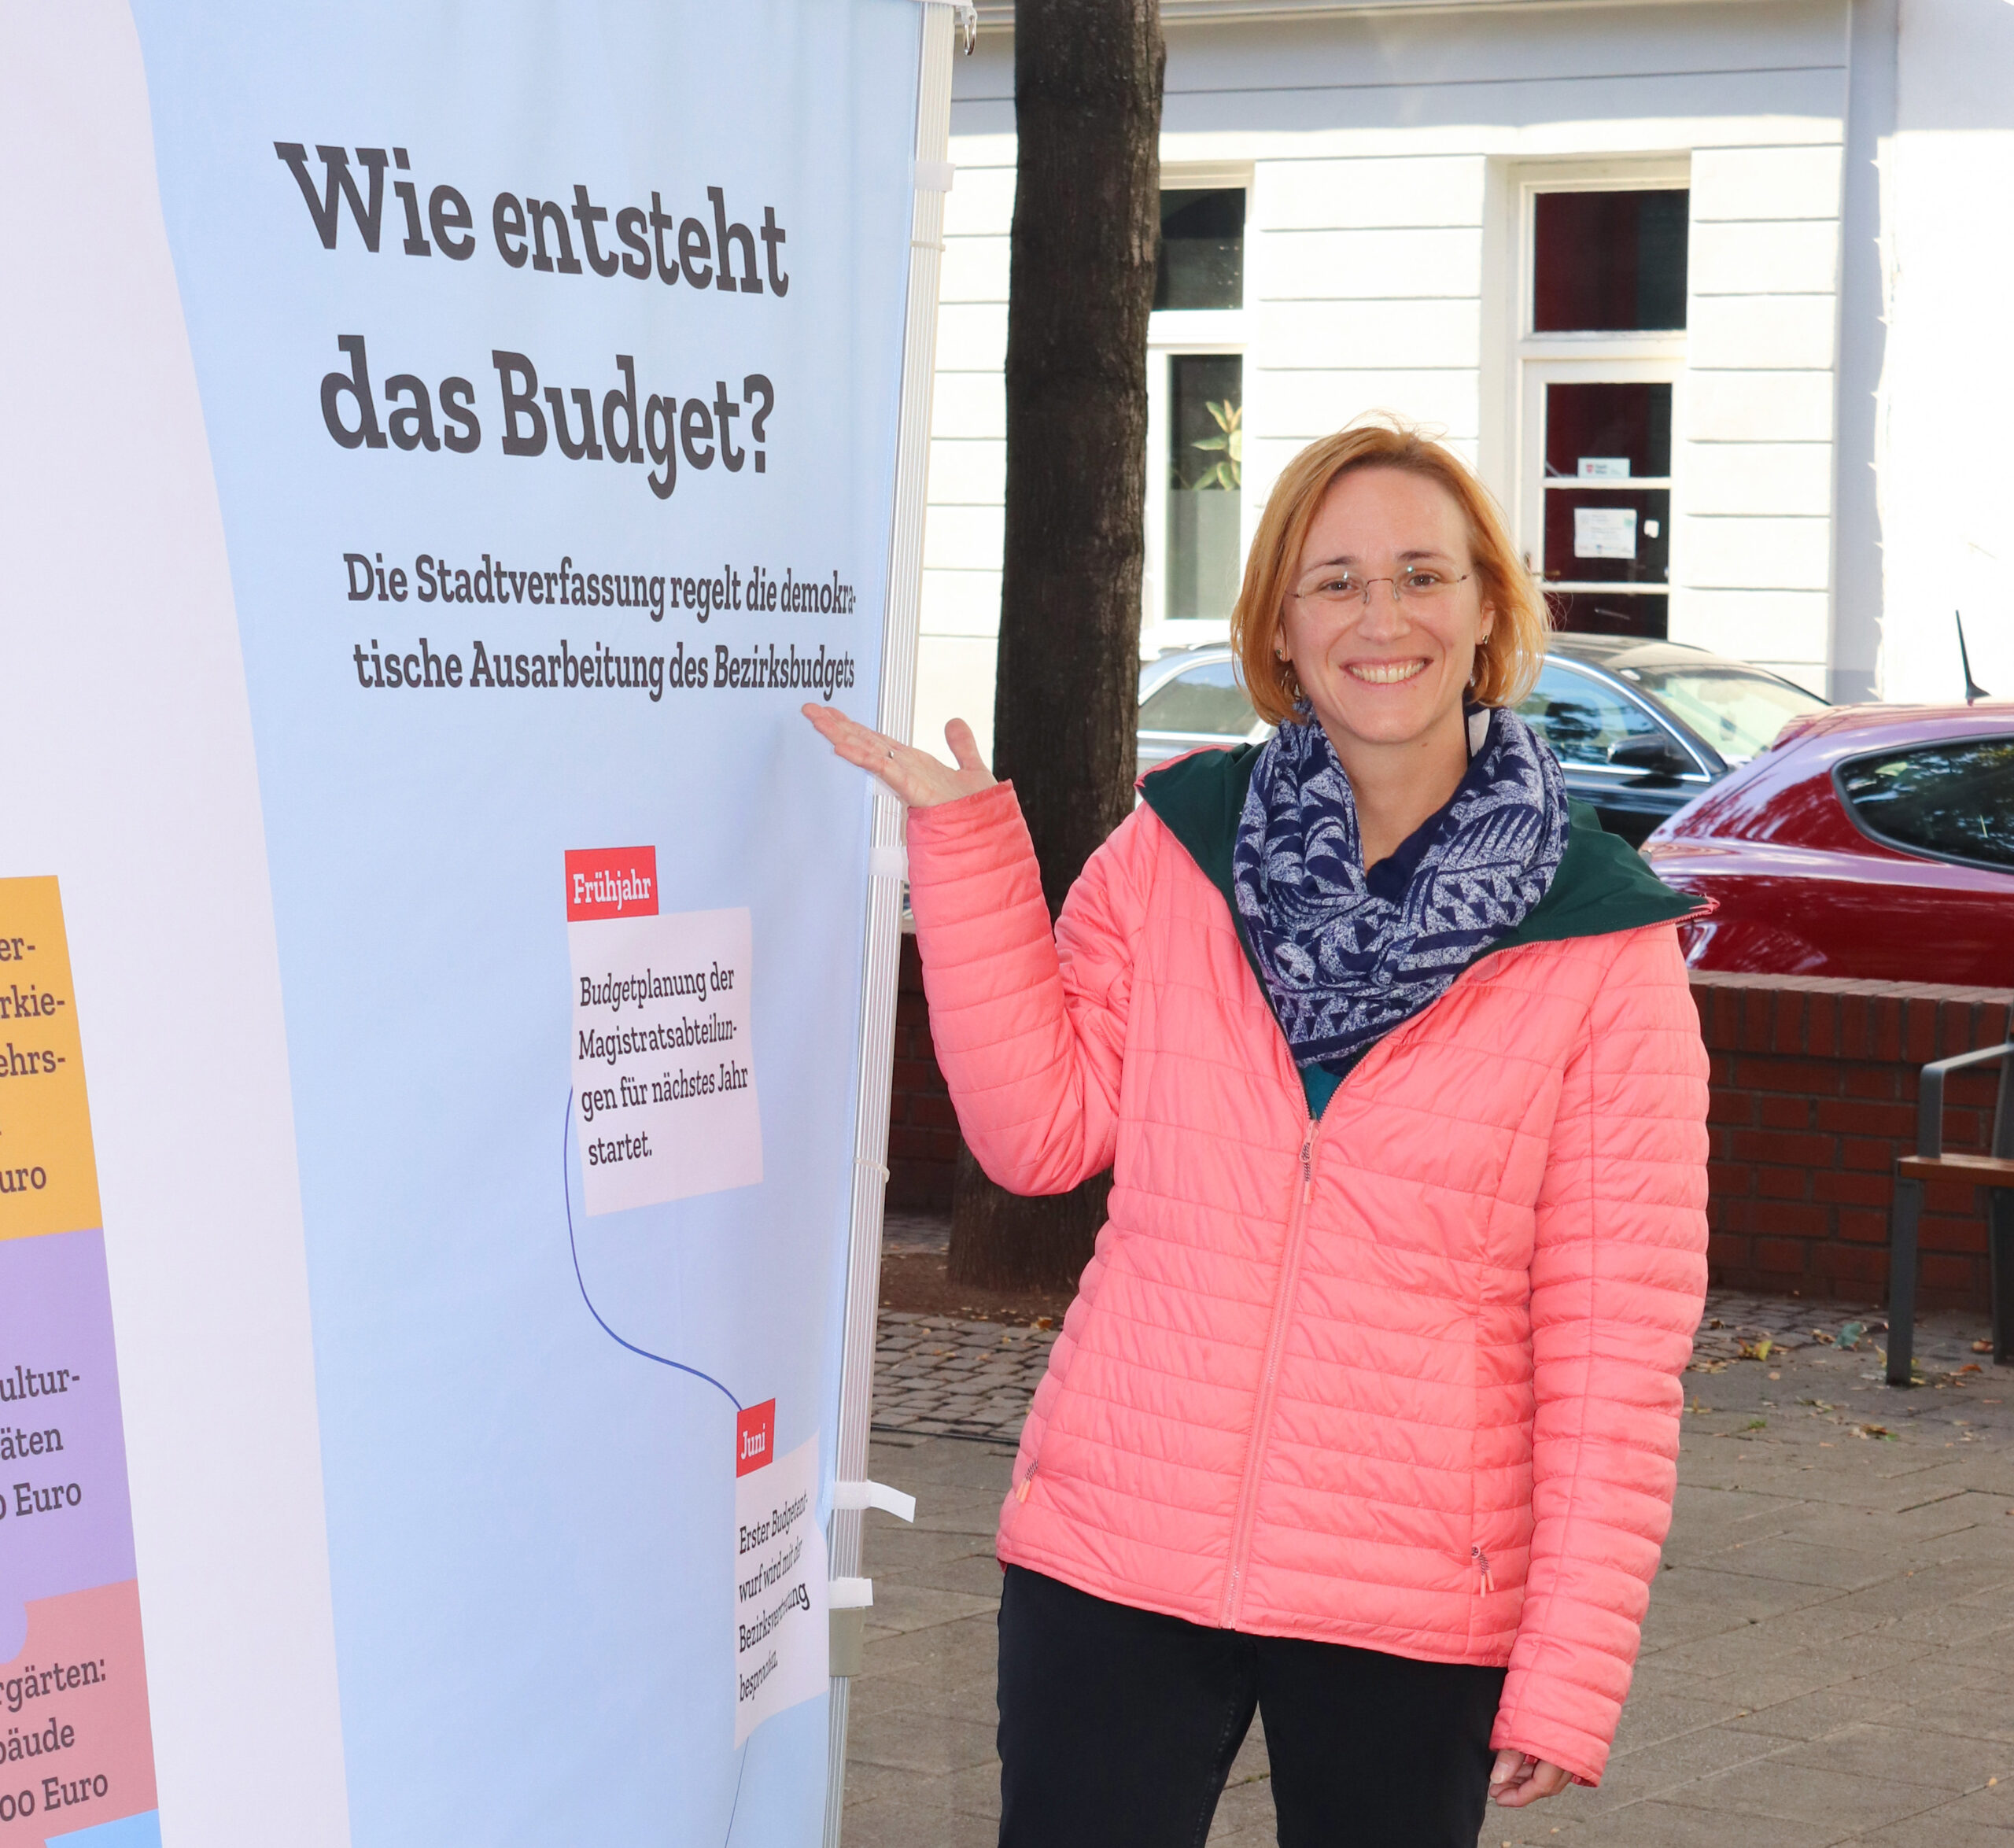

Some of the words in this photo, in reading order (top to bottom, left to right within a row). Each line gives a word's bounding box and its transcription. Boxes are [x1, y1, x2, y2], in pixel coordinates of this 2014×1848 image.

[274, 142, 475, 260] Wie
[492, 185, 788, 297] entsteht
[319, 334, 481, 453] das
[492, 350, 774, 499] Budget?
[343, 553, 408, 601] Die
[416, 554, 665, 622] Stadtverfassung
[671, 565, 740, 623] regelt
[746, 566, 776, 613] die
[781, 567, 856, 614] demokra-
[353, 638, 463, 688] tische
[470, 640, 663, 702] Ausarbeitung
[669, 642, 708, 688] des
[714, 644, 854, 702] Bezirksbudgets
[573, 869, 651, 911] Frühjahr
[580, 968, 706, 1013] Budgetplanung
[710, 961, 735, 993] der
[578, 1013, 737, 1065] Magistratsabteilun-
[581, 1088, 618, 1122] gen
[620, 1076, 647, 1108] für
[652, 1068, 715, 1103] nächstes
[717, 1060, 748, 1091] Jahr
[588, 1131, 652, 1166] startet.
[0, 1365, 80, 1402] ultur-
[0, 1426, 64, 1460] äten
[740, 1422, 765, 1460] Juni
[13, 1482, 82, 1517] Euro
[740, 1521, 770, 1555] Erster
[771, 1488, 808, 1536] Budgetent-
[739, 1562, 763, 1603] wurf
[763, 1550, 782, 1589] wird
[782, 1543, 794, 1576] mit
[0, 1658, 106, 1713] gärten:
[42, 1773, 109, 1812] Euro
